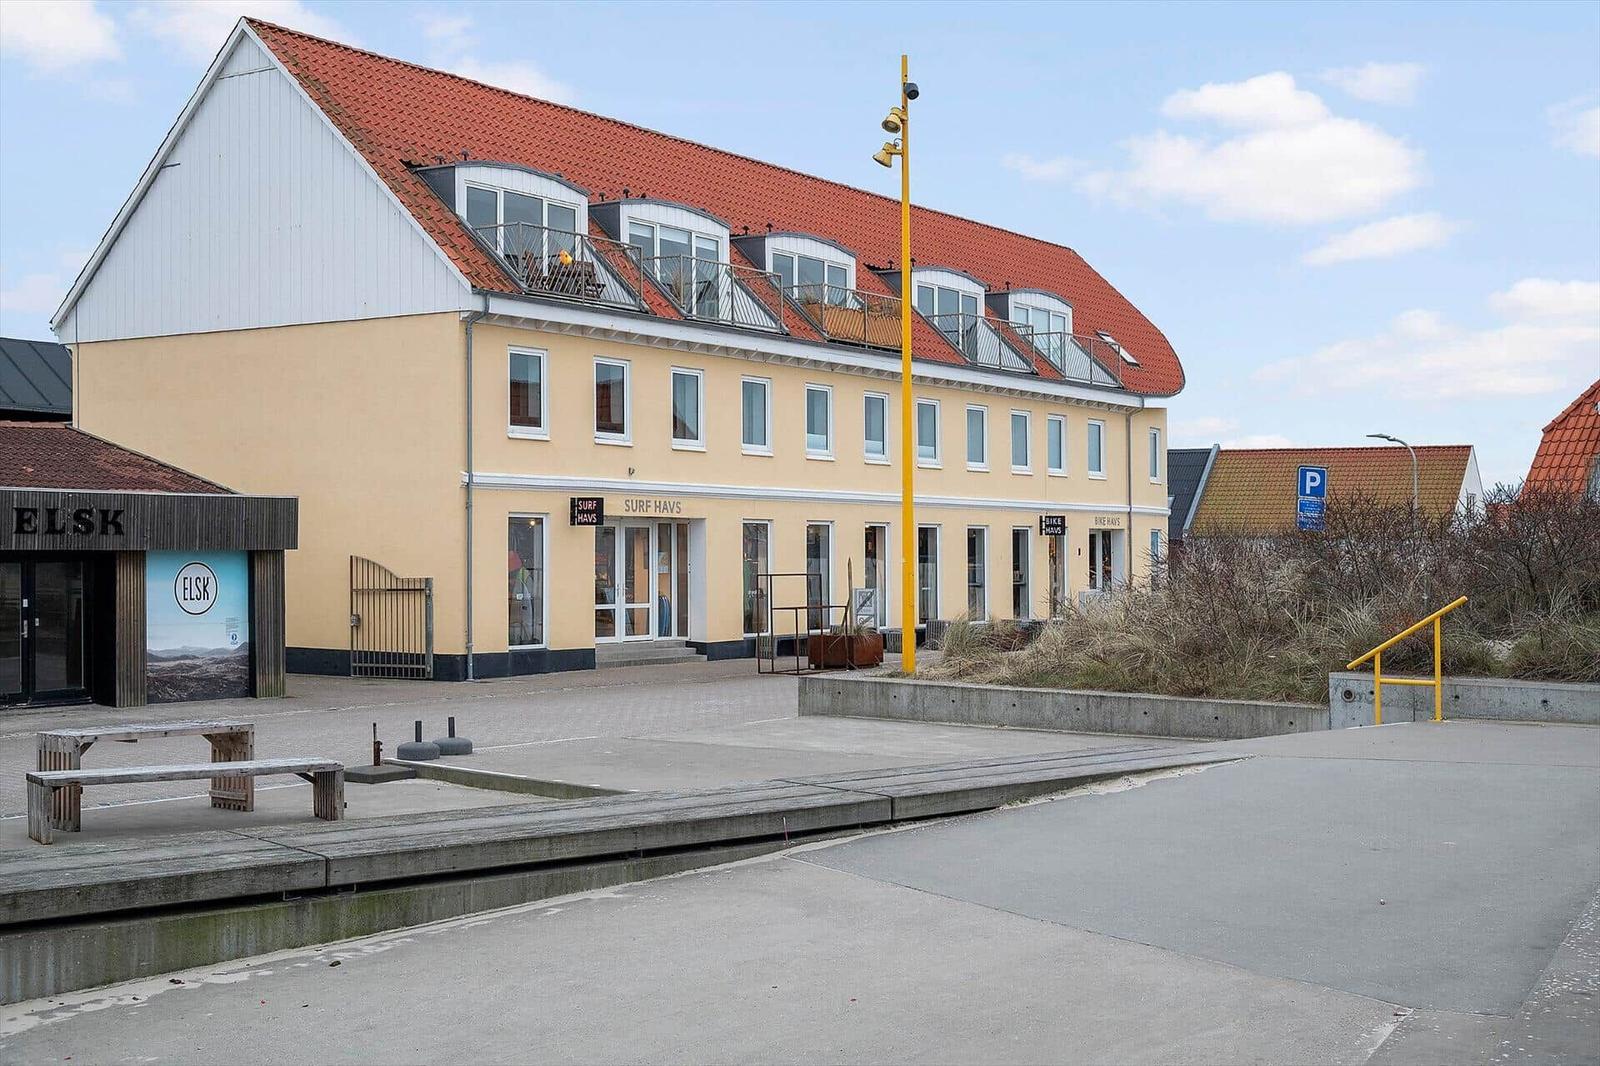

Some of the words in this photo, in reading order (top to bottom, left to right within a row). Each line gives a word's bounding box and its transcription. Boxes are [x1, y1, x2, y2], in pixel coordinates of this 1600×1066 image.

[1306, 471, 1321, 494] P
[578, 500, 597, 510] SURF
[624, 499, 652, 513] SURF
[654, 500, 682, 514] HAVS
[14, 507, 125, 536] ELSK
[577, 513, 597, 523] HAVS
[1045, 517, 1062, 525] BIKE
[1095, 516, 1107, 526] BIKE
[1107, 517, 1121, 526] HAVS
[183, 576, 210, 601] ELSK
